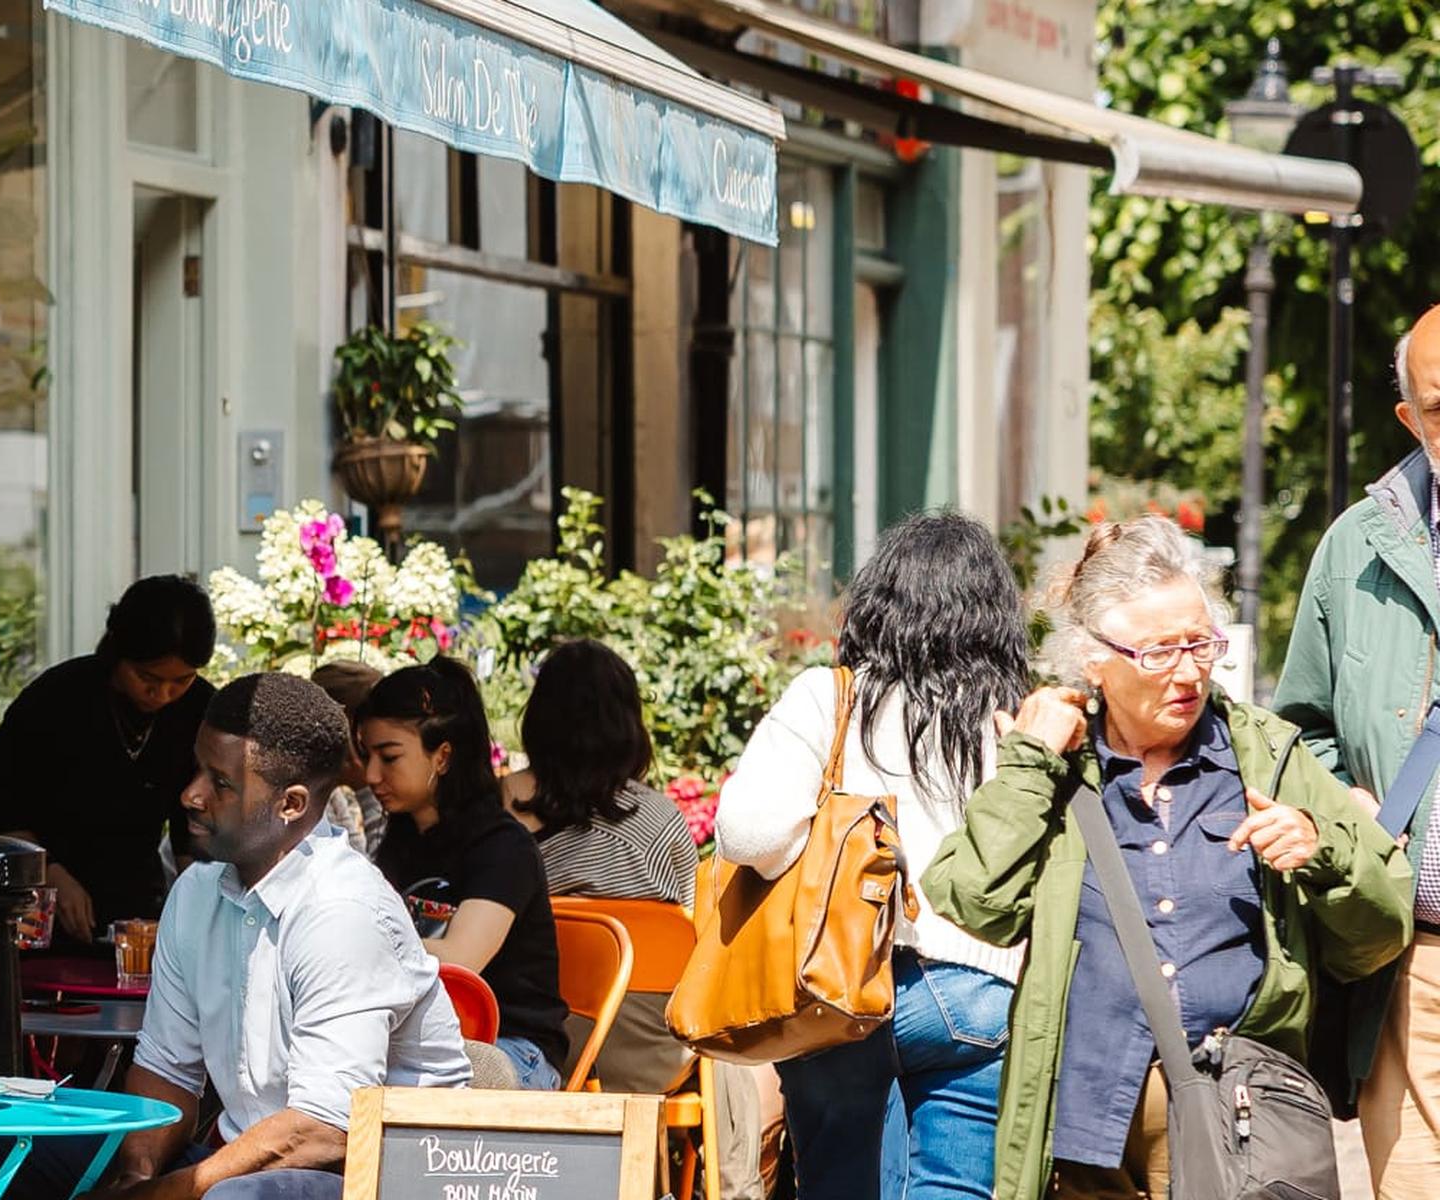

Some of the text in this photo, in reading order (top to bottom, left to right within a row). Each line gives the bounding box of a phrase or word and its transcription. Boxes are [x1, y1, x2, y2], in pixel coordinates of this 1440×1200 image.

[170, 0, 293, 63] uangerie
[421, 39, 469, 128] Salon
[473, 59, 505, 136] De
[419, 1134, 559, 1191] Boulangerie
[442, 1184, 480, 1200] BON
